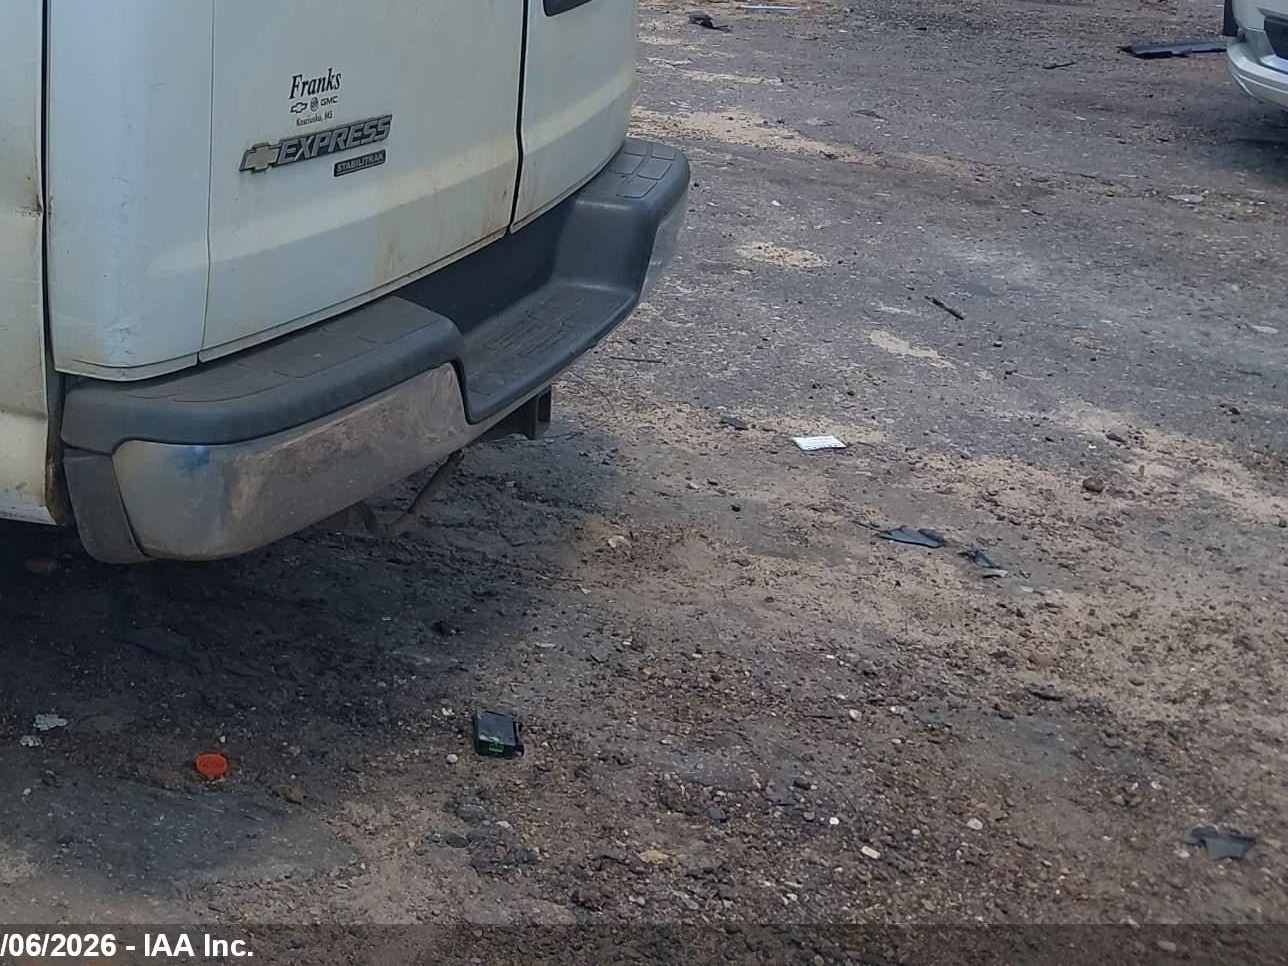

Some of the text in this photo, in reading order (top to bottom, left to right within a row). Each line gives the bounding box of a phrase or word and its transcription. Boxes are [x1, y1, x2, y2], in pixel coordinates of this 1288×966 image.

[288, 67, 342, 99] Franks
[320, 96, 338, 106] GMC
[277, 117, 391, 165] EXPRESS
